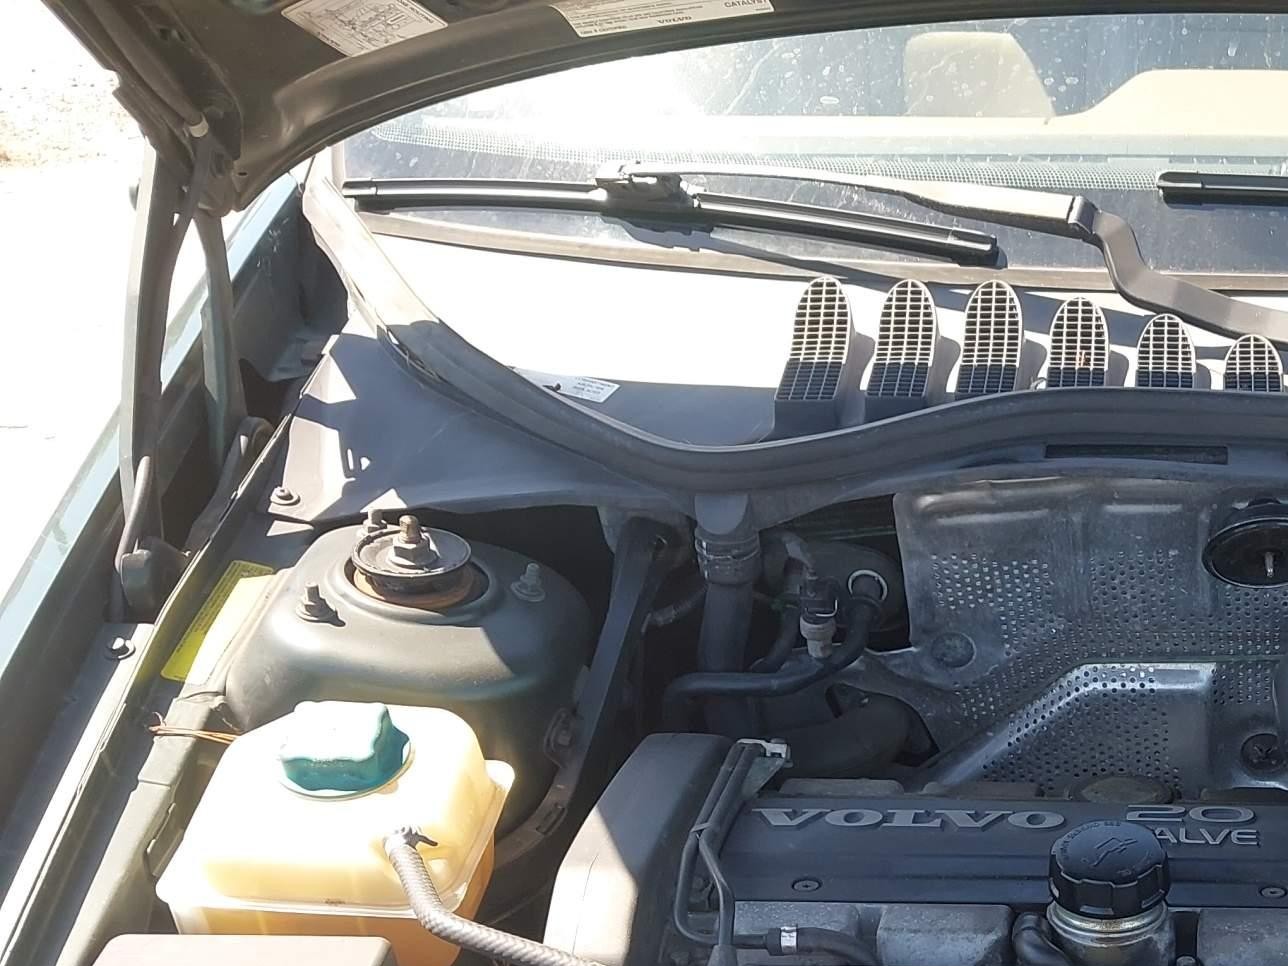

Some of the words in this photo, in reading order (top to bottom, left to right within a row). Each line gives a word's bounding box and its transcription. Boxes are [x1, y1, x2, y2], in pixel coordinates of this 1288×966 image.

[752, 808, 1066, 831] VOLVO
[1123, 804, 1256, 826] 20
[1155, 827, 1261, 848] ALVE
